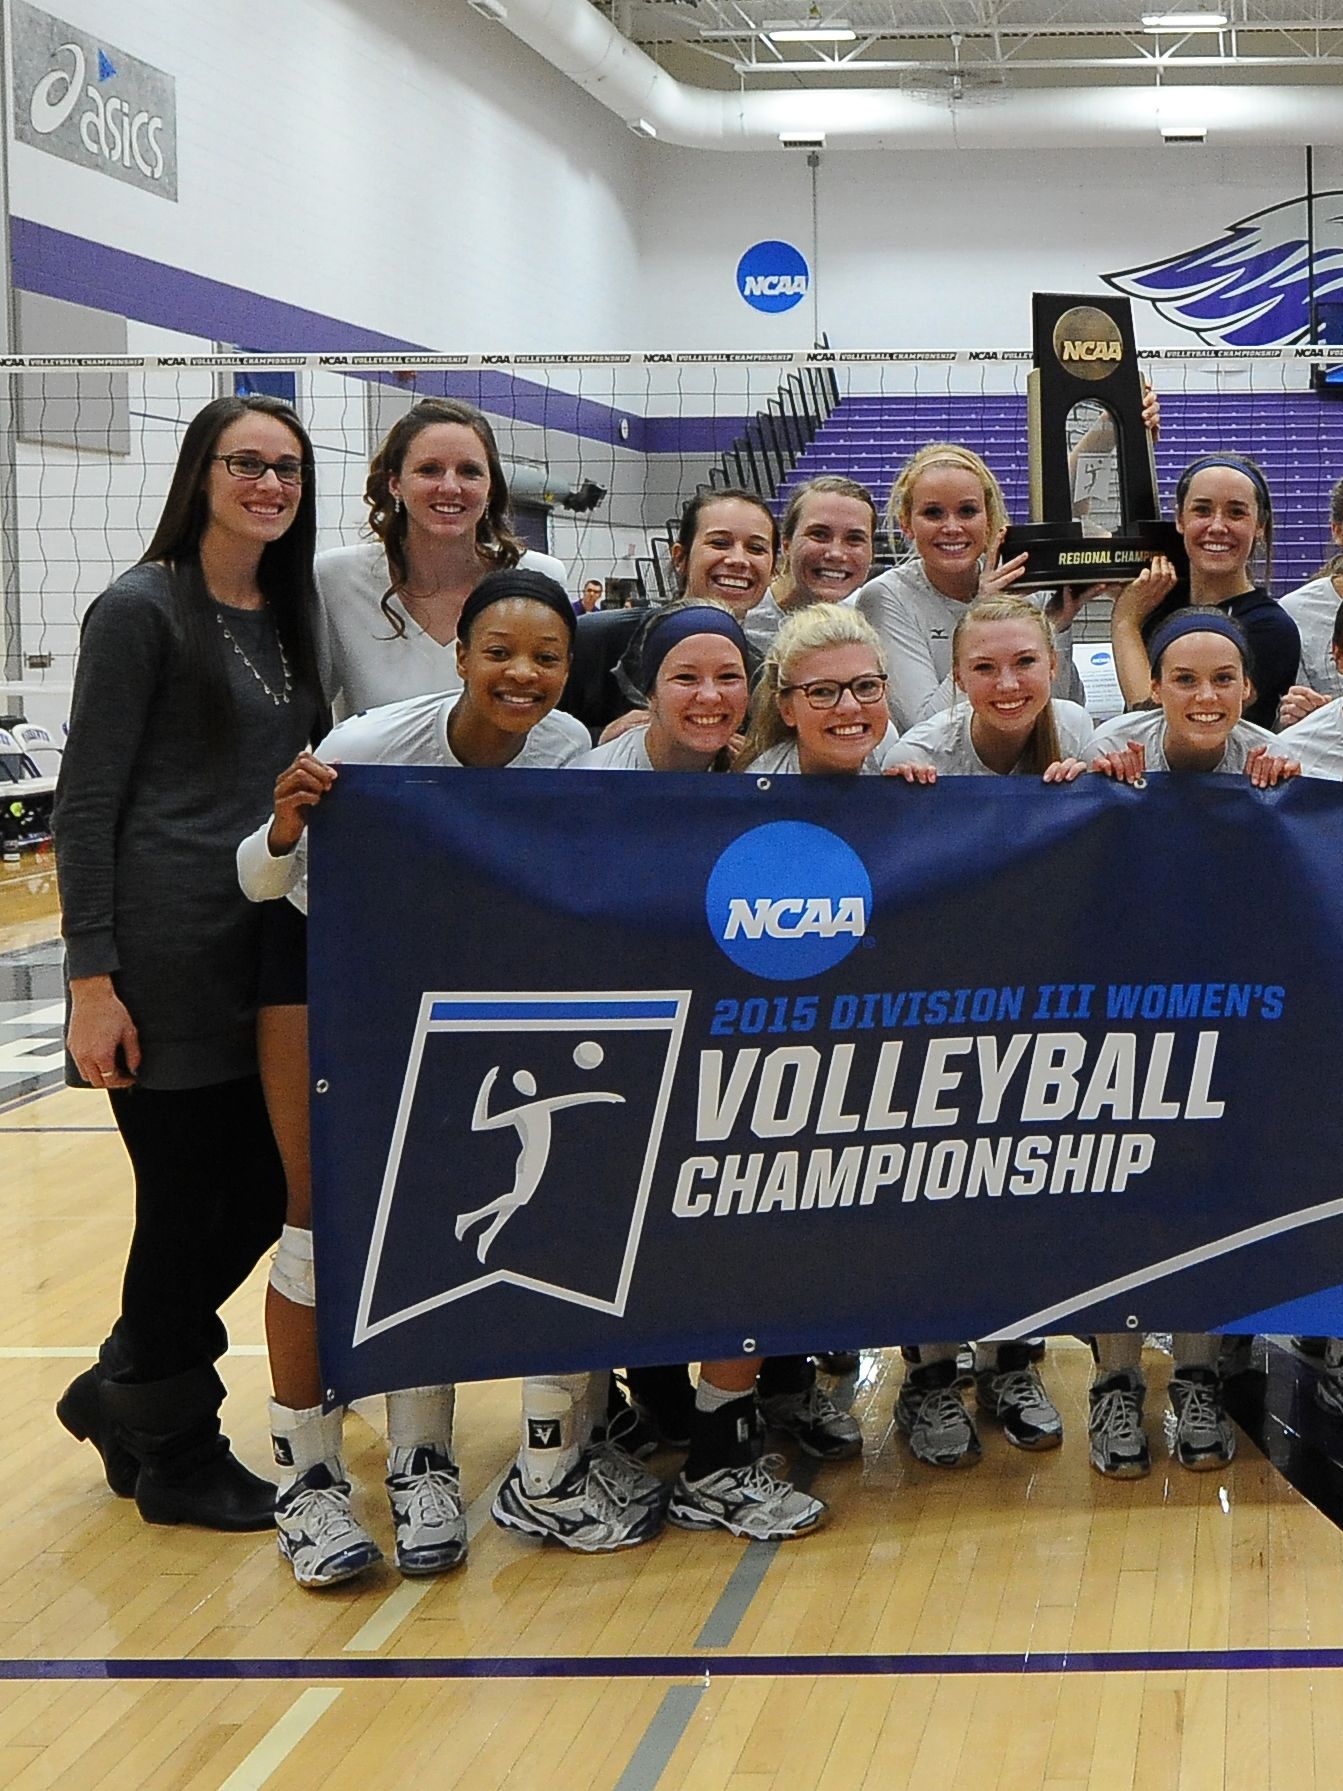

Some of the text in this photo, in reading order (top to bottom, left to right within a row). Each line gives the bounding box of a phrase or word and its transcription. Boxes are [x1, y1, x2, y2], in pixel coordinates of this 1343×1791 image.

[80, 83, 163, 180] asics
[744, 275, 806, 296] NCAA
[1062, 340, 1122, 361] NCAA
[1166, 349, 1216, 358] VOLLEYBALL
[1218, 349, 1280, 358] CHAMPIONSHIP
[1294, 348, 1323, 358] NCAA
[318, 356, 467, 365] NCAA VOLLEYBALL CHAMPIONSHIP
[480, 355, 629, 364] NCAA VOLLEYBALL CHAMPIONSHIP
[643, 354, 792, 363] NCAA VOLLEYBALL CHAMPIONSHIP
[806, 352, 955, 362] NCAA VOLLEYBALL CHAMPIONSHIP
[968, 351, 997, 361] NCAA
[30, 358, 80, 366] VOLLEYBALL
[82, 358, 144, 366] CHAMPIONSHIP
[157, 357, 305, 366] NCAA VOLLEYBALL CHAMPIONSHIP
[1058, 550, 1112, 565] REGIONAL
[723, 896, 866, 940] NCAA
[710, 983, 1286, 1035] 2015 DIVISION III WOMEN'S
[695, 1031, 1226, 1142] VOLLEYBALL
[671, 1133, 1156, 1219] CHAMPIONSHIP
